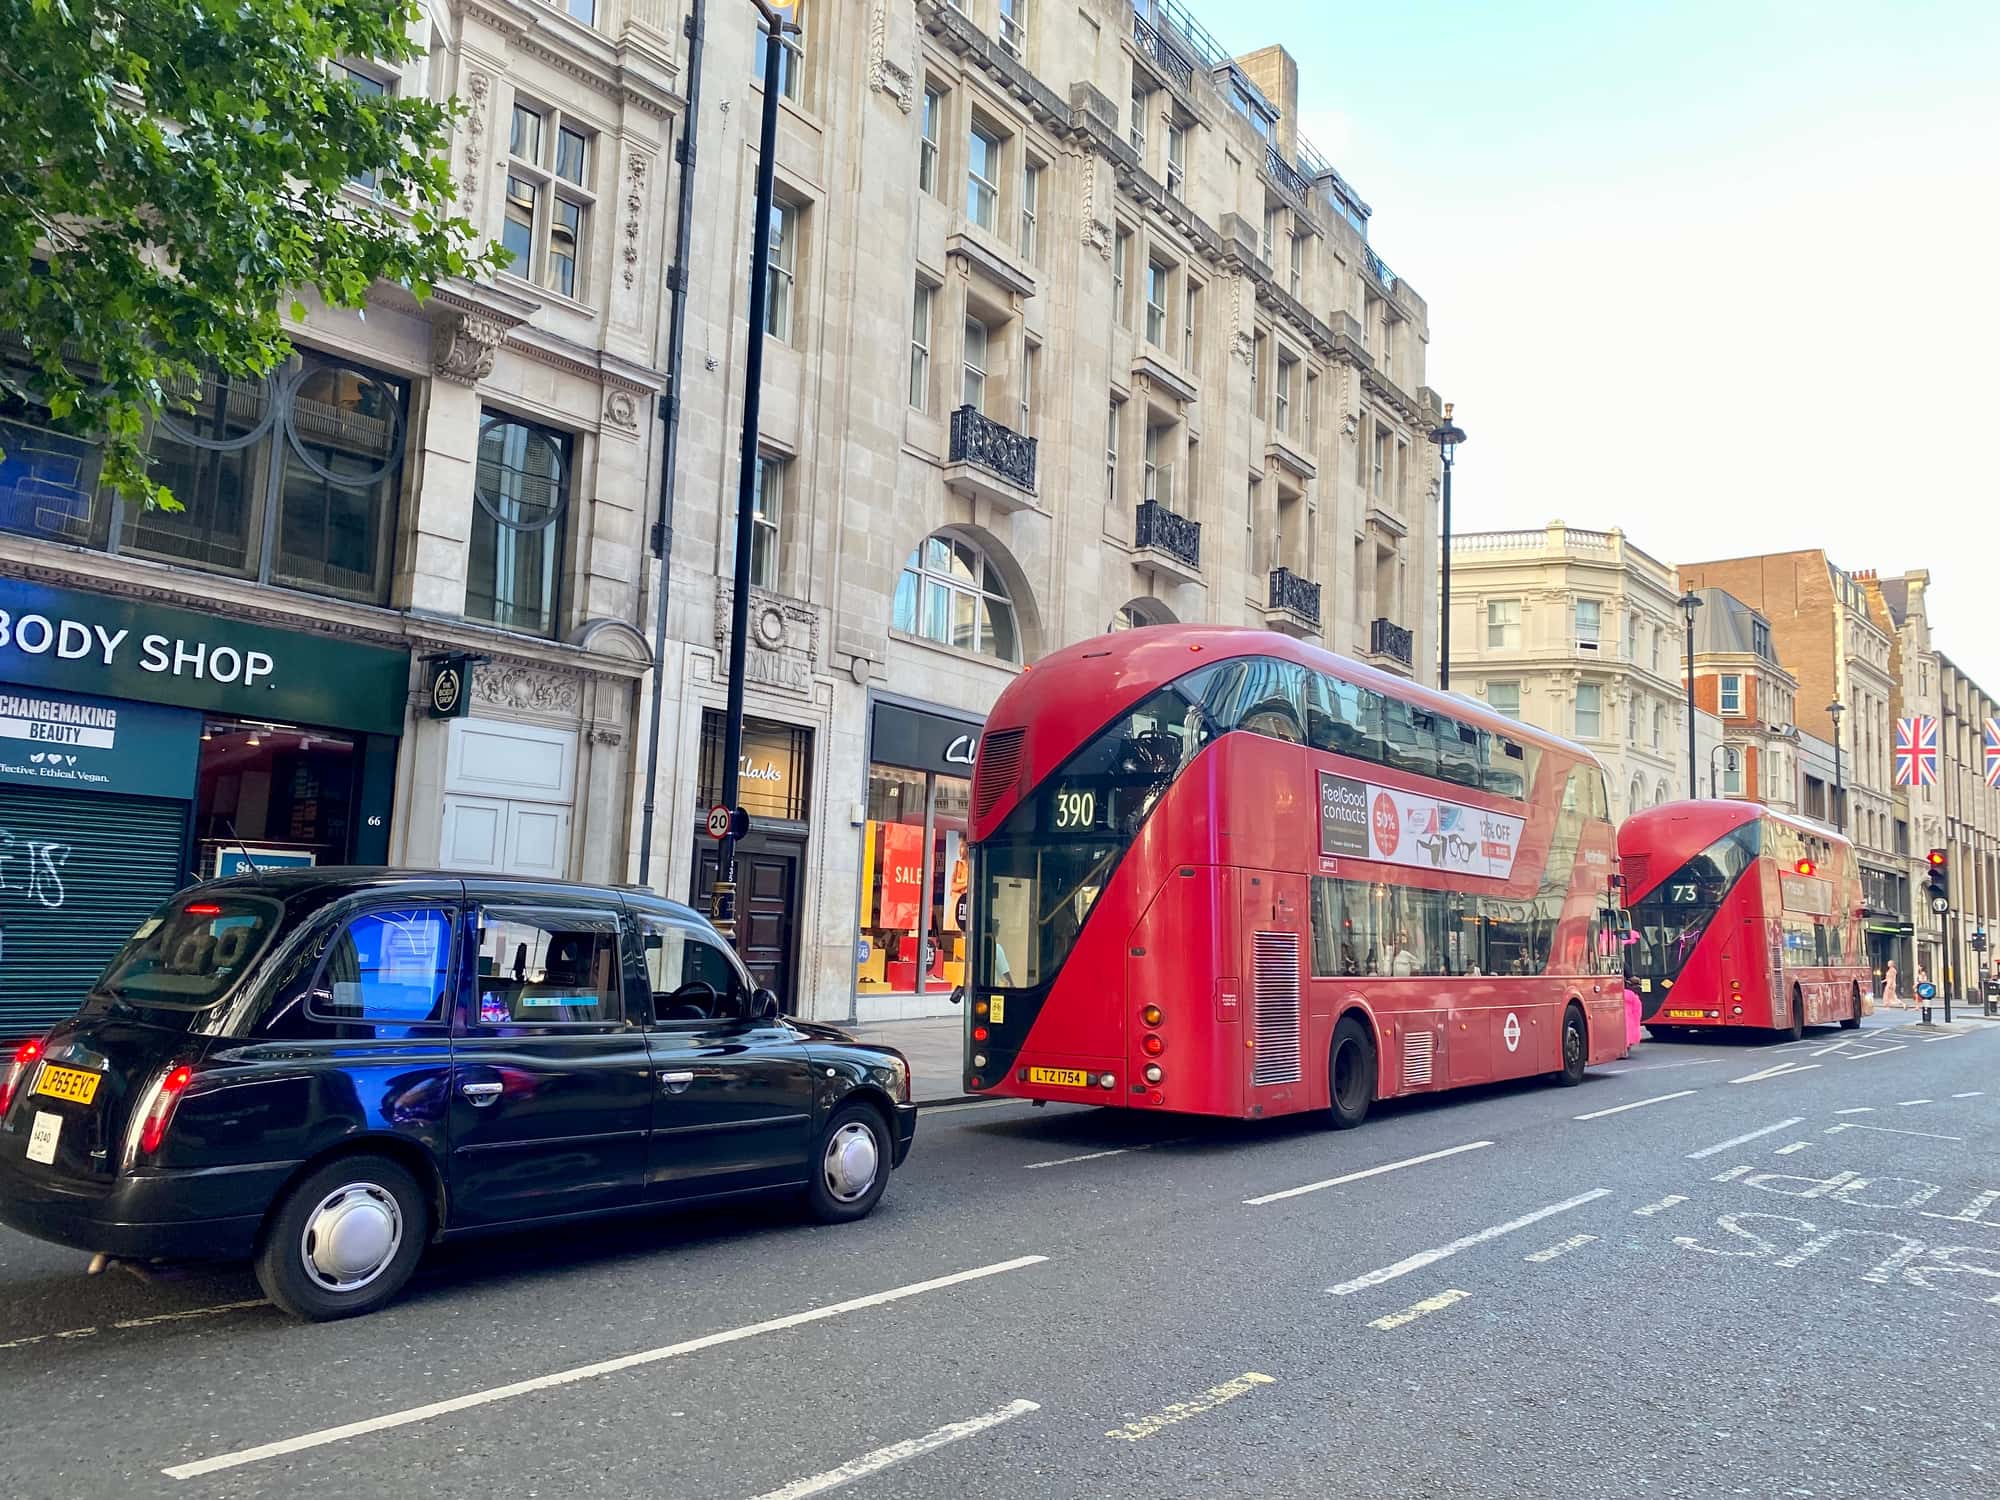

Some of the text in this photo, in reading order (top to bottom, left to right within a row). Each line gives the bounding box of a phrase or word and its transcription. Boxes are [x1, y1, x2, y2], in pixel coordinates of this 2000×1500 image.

[0, 695, 117, 728] CHANGEMAKING
[30, 723, 81, 743] BEAUTY
[1322, 783, 1365, 807] FeelGood
[1056, 793, 1094, 827] 390
[1323, 805, 1366, 825] contacts
[367, 816, 381, 826] 66
[711, 815, 727, 829] 20
[895, 866, 922, 885] SALE
[1672, 885, 1697, 901] 73
[1743, 1170, 2000, 1227] TOP
